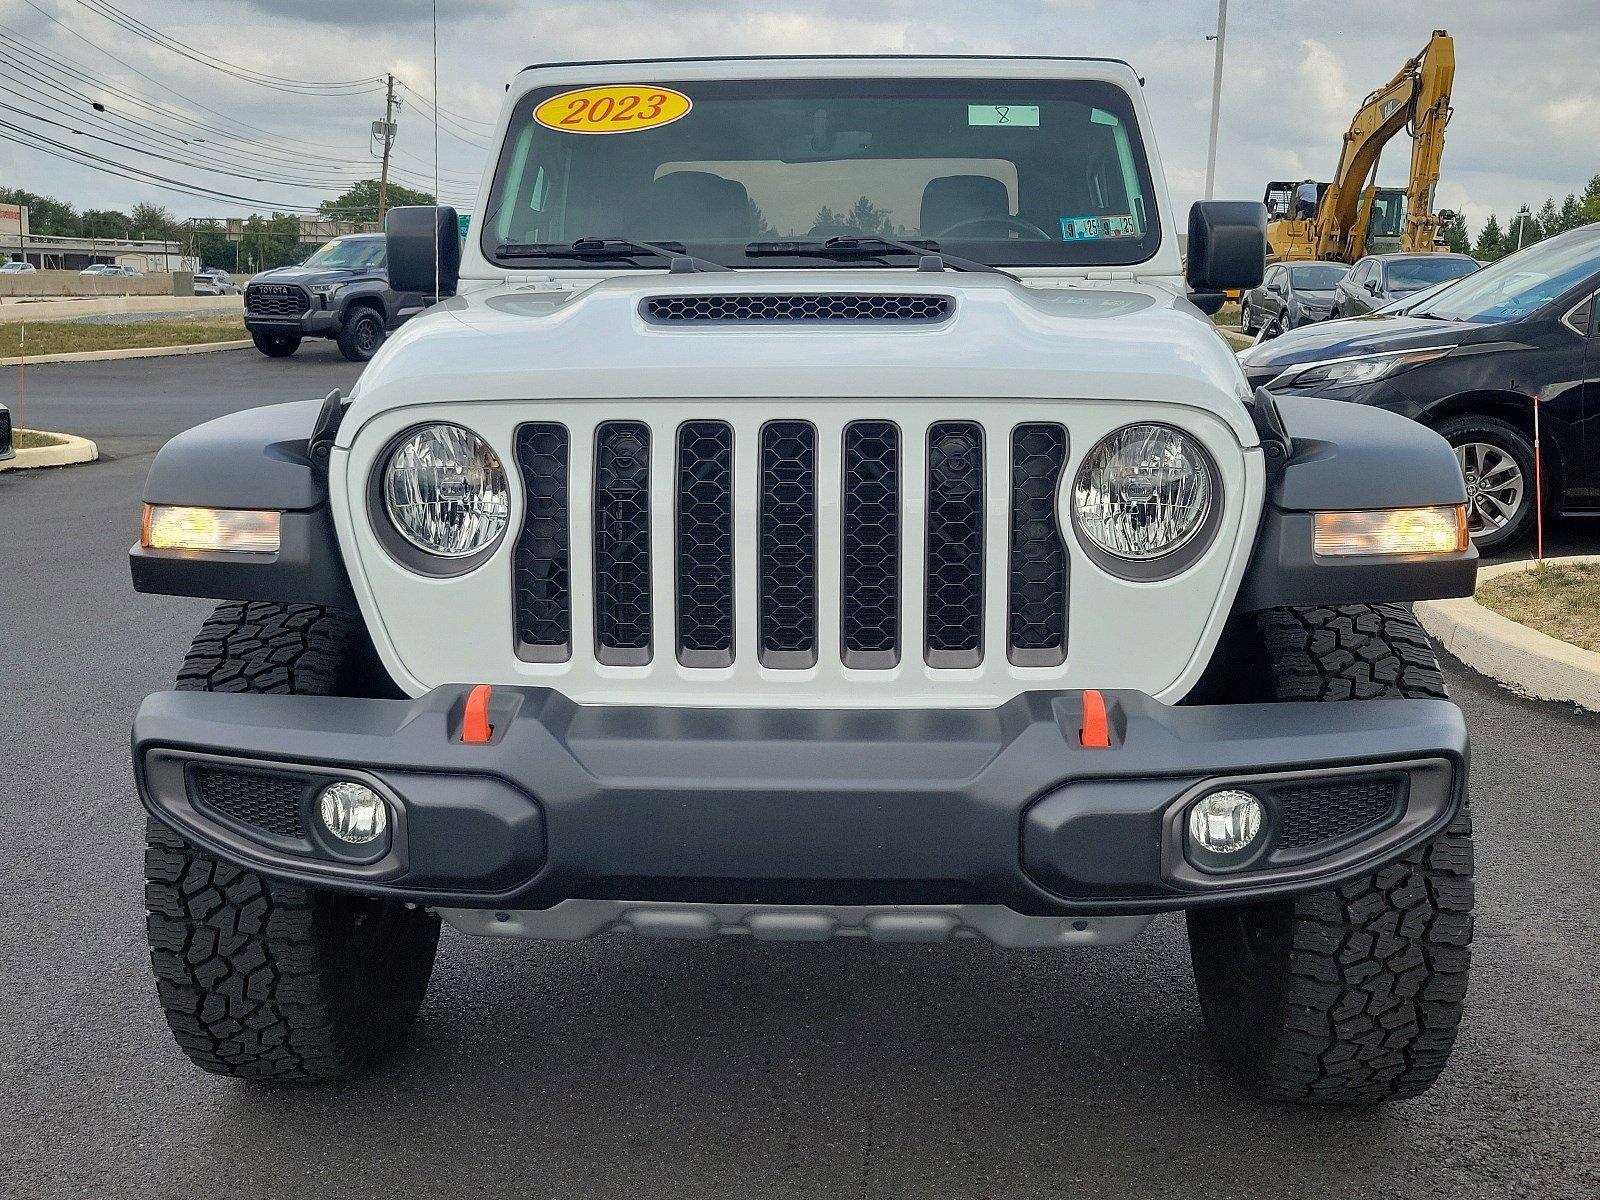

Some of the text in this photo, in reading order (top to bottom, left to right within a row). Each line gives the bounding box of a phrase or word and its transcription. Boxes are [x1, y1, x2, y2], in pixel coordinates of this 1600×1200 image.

[559, 94, 668, 125] 2023
[995, 105, 1010, 124] 8
[1067, 219, 1098, 238] 9 25
[1103, 217, 1134, 236] 9 25
[259, 286, 288, 294] TOYOTA
